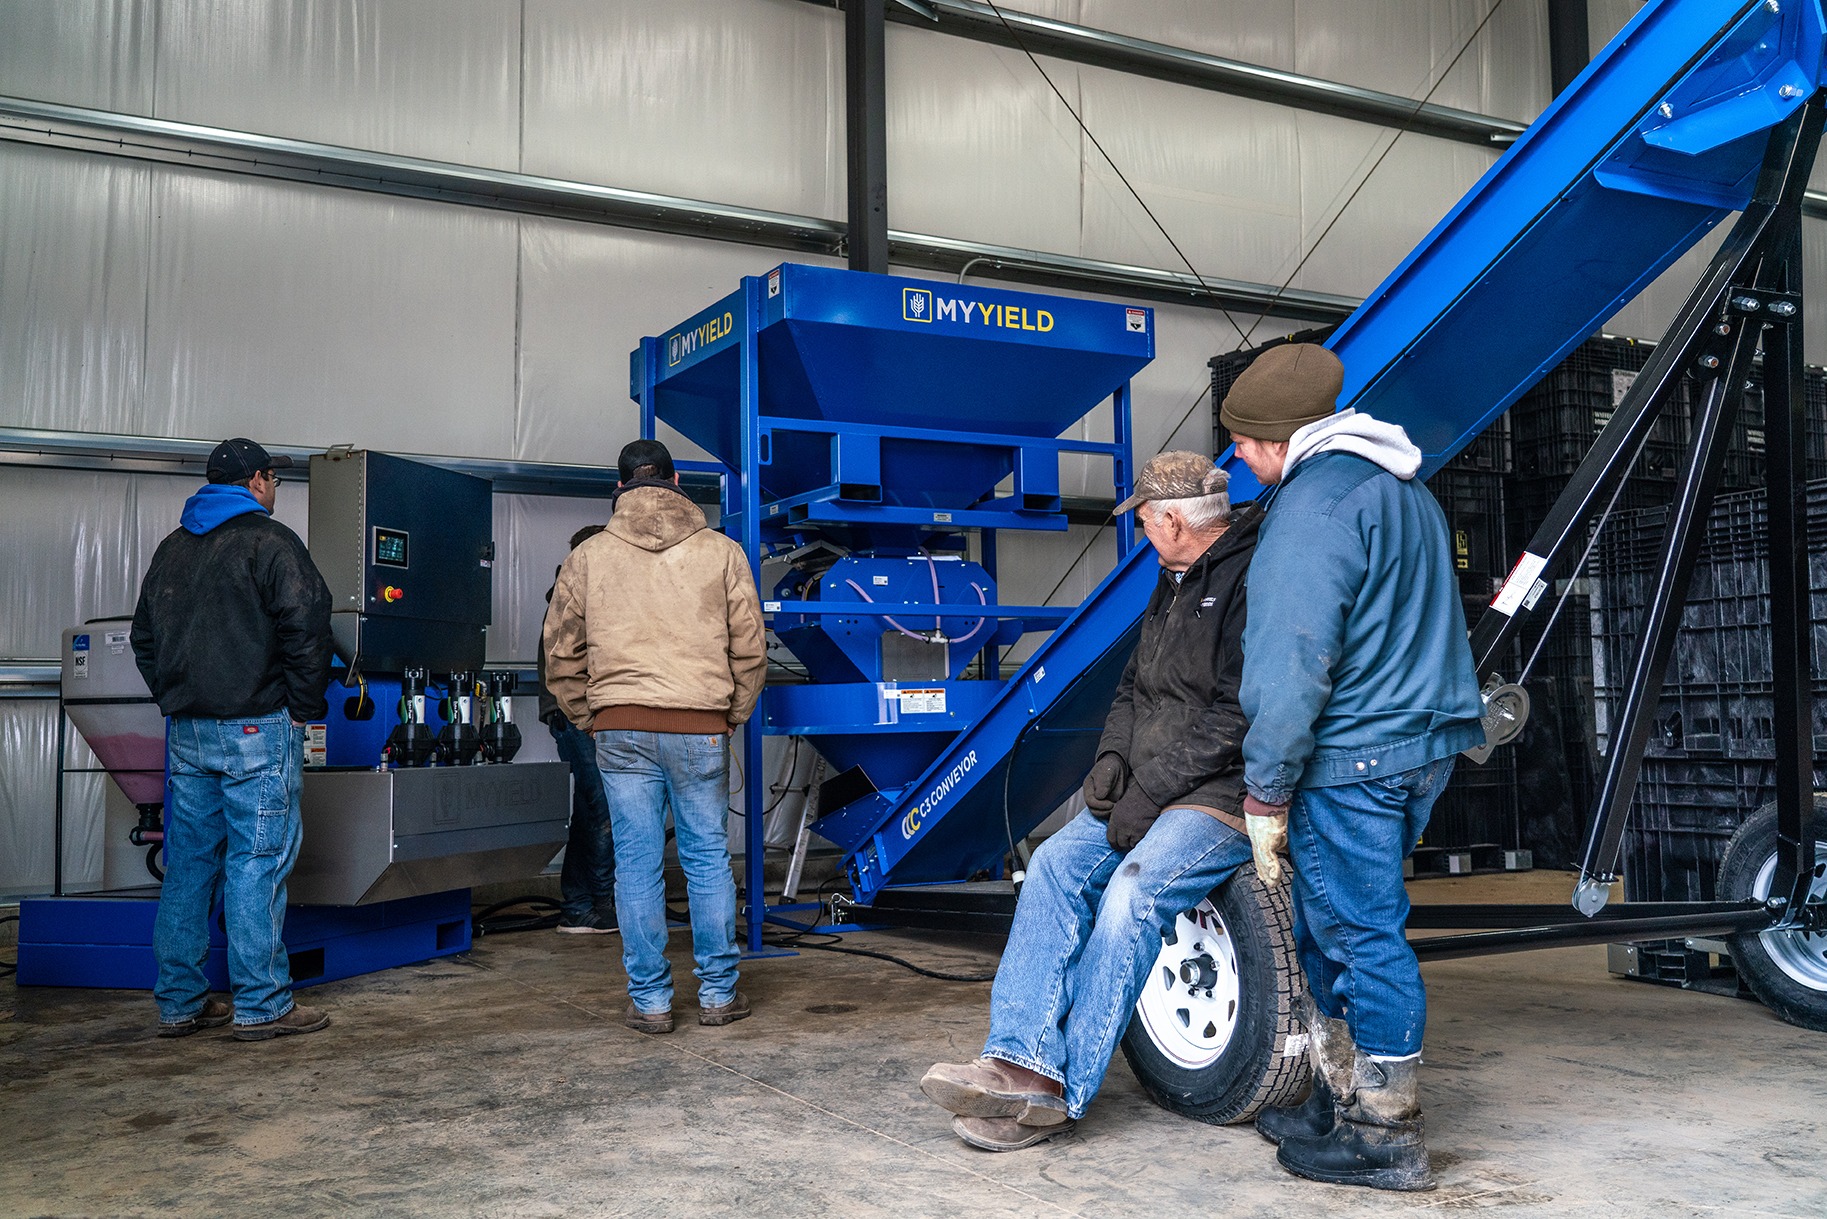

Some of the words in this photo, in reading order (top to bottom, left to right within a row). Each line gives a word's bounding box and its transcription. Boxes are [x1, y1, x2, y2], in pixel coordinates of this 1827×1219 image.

[681, 311, 733, 357] MYYIELD
[936, 297, 1055, 333] MYYIELD
[75, 656, 86, 666] NSF
[919, 797, 932, 818] C3
[930, 749, 978, 806] CONVEYOR
